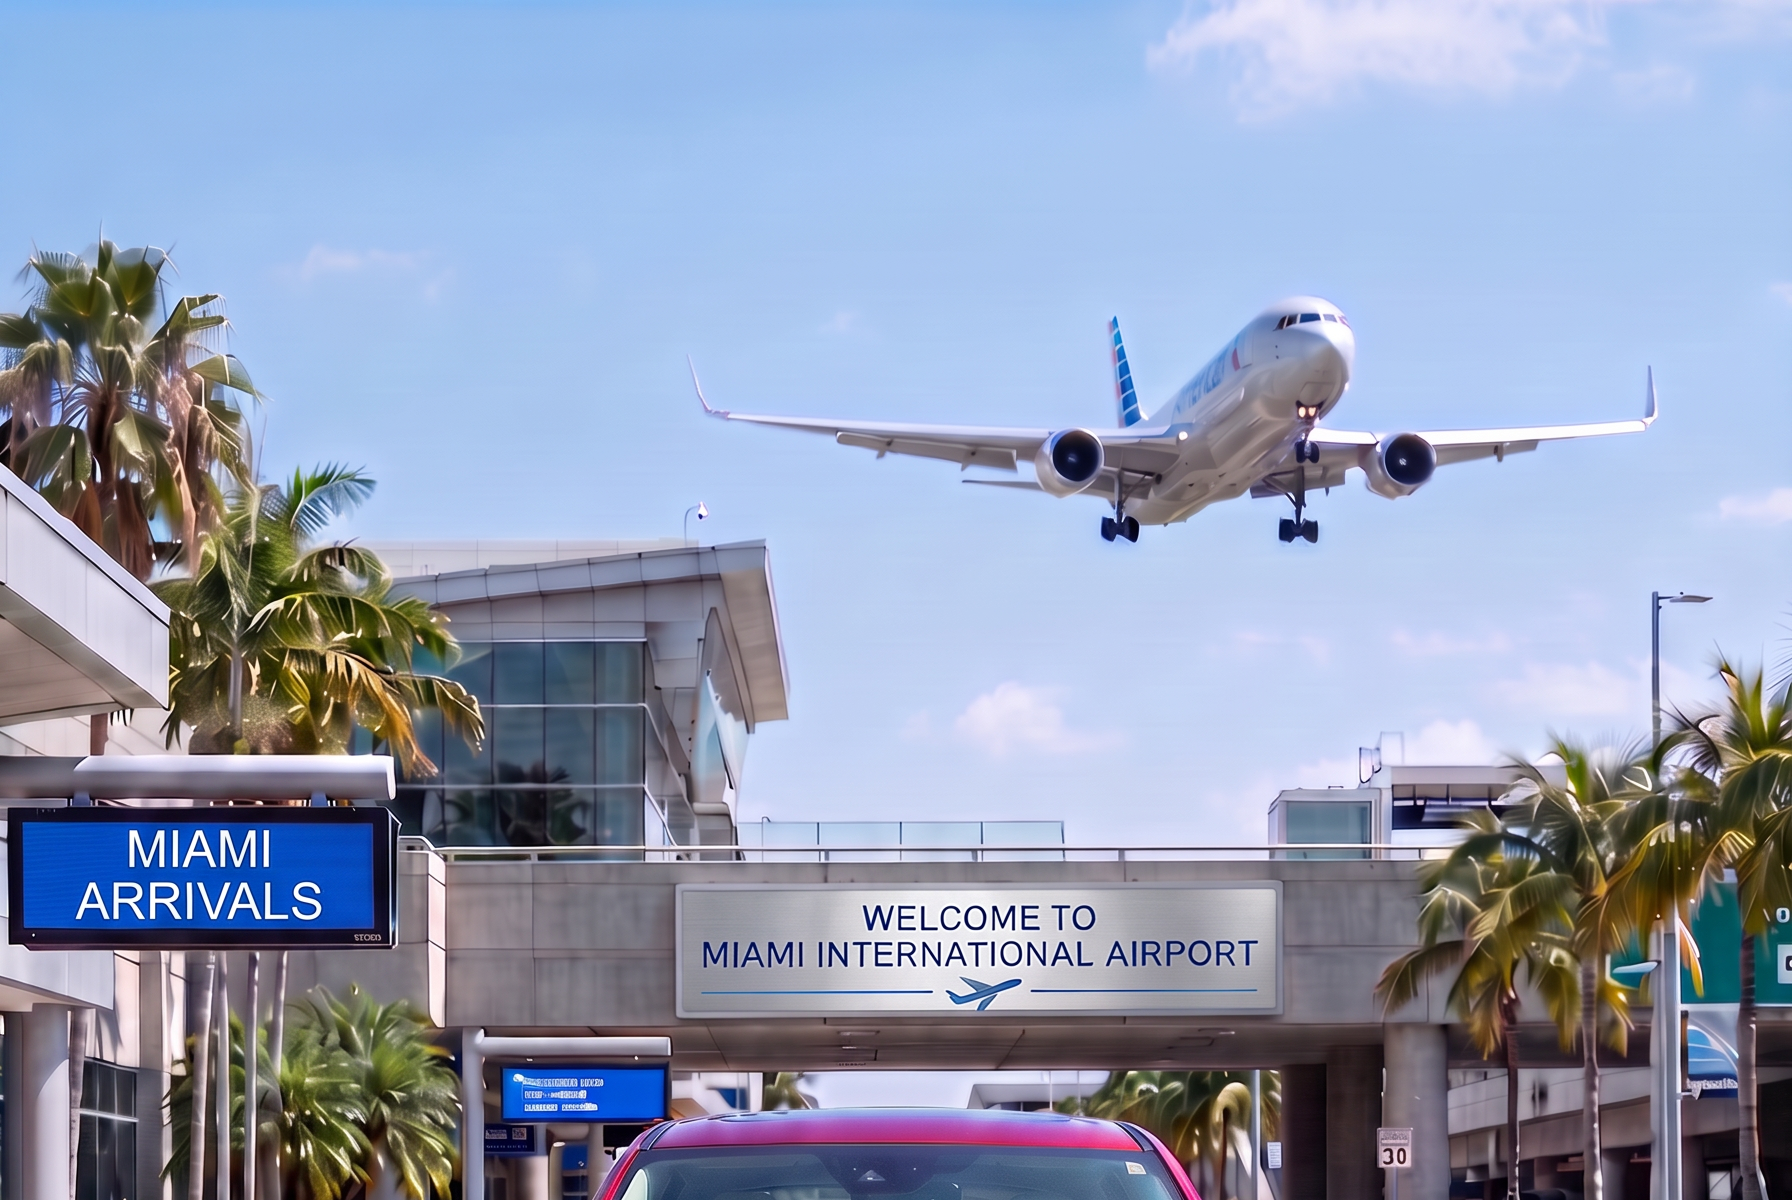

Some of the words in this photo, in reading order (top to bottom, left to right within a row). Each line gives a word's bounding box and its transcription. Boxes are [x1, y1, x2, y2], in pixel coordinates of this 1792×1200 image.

[128, 829, 270, 868] MIAMI
[75, 881, 322, 921] ARRIVALS
[862, 905, 1041, 931] WELCOME
[1051, 904, 1096, 931] TO
[702, 941, 804, 969] MIAMI
[818, 940, 1094, 968] INTERNATIONAL
[1105, 939, 1259, 967] AIRPORT
[1383, 1148, 1406, 1165] 30
